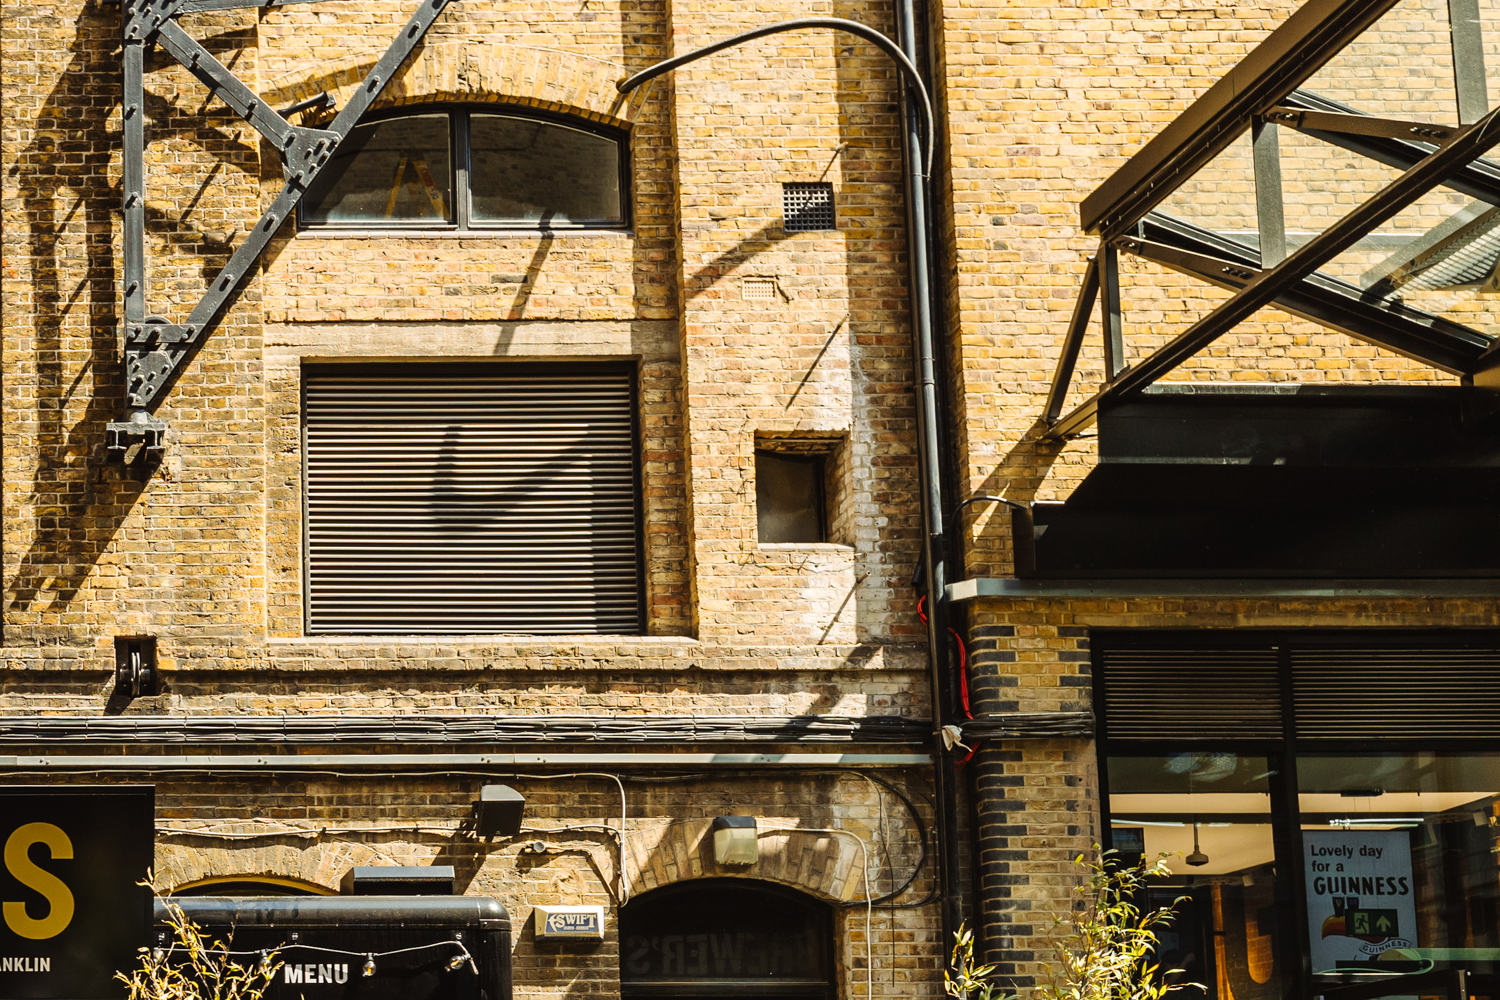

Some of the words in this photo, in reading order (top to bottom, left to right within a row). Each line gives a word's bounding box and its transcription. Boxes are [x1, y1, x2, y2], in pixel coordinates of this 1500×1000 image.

[1310, 845, 1353, 859] Lovely
[1359, 845, 1383, 859] day
[1312, 860, 1330, 872] for
[1336, 862, 1344, 872] a
[1314, 877, 1409, 895] GUINNESS
[555, 914, 596, 928] SWIFT
[1362, 941, 1407, 953] GUINNESS
[284, 963, 348, 984] MENU
